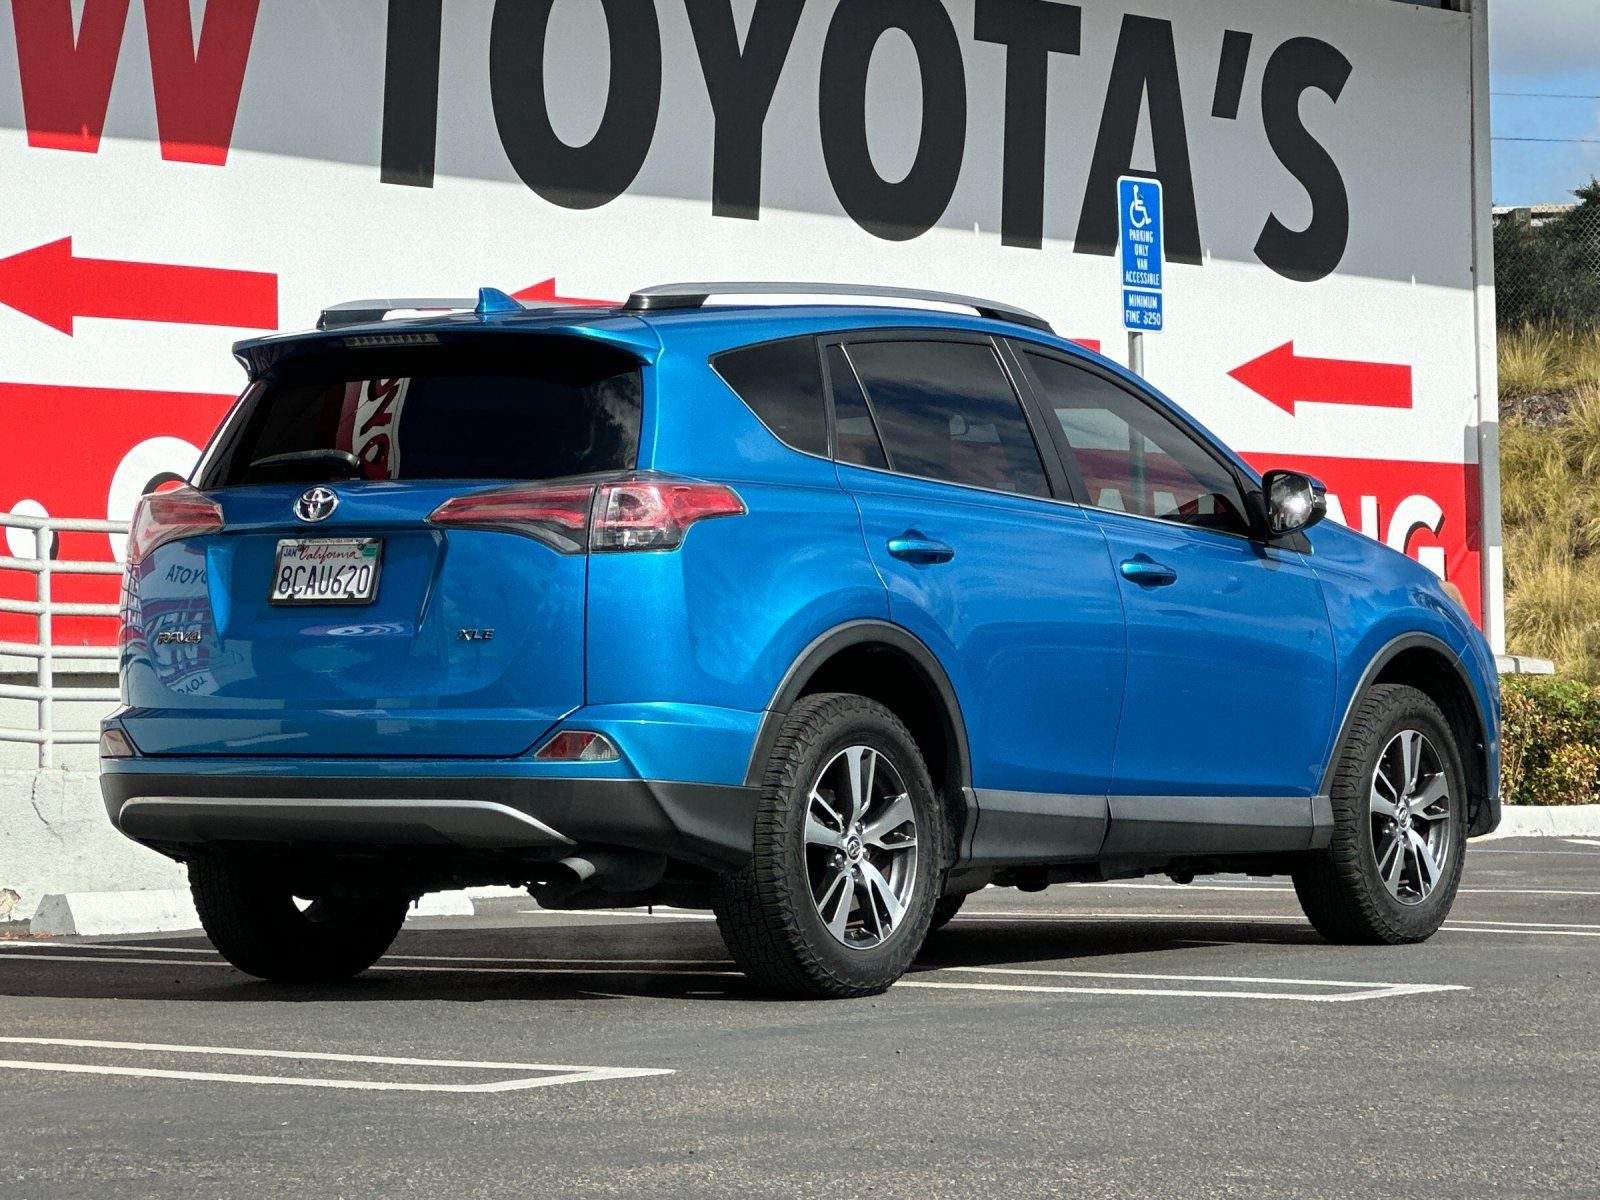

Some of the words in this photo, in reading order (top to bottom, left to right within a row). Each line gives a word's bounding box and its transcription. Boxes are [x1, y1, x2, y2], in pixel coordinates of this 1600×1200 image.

[1128, 228, 1154, 243] PARKING
[1134, 244, 1150, 257] ONLY
[1136, 258, 1149, 271] VAN
[1125, 271, 1160, 286] ACCESSIBLE
[1128, 294, 1158, 309] MINIMUM
[1125, 310, 1141, 324] FINE
[1143, 311, 1161, 326] $250
[298, 545, 359, 564] California
[278, 564, 371, 596] 8CAU620
[156, 630, 202, 645] RAV4
[457, 628, 496, 641] XLE
